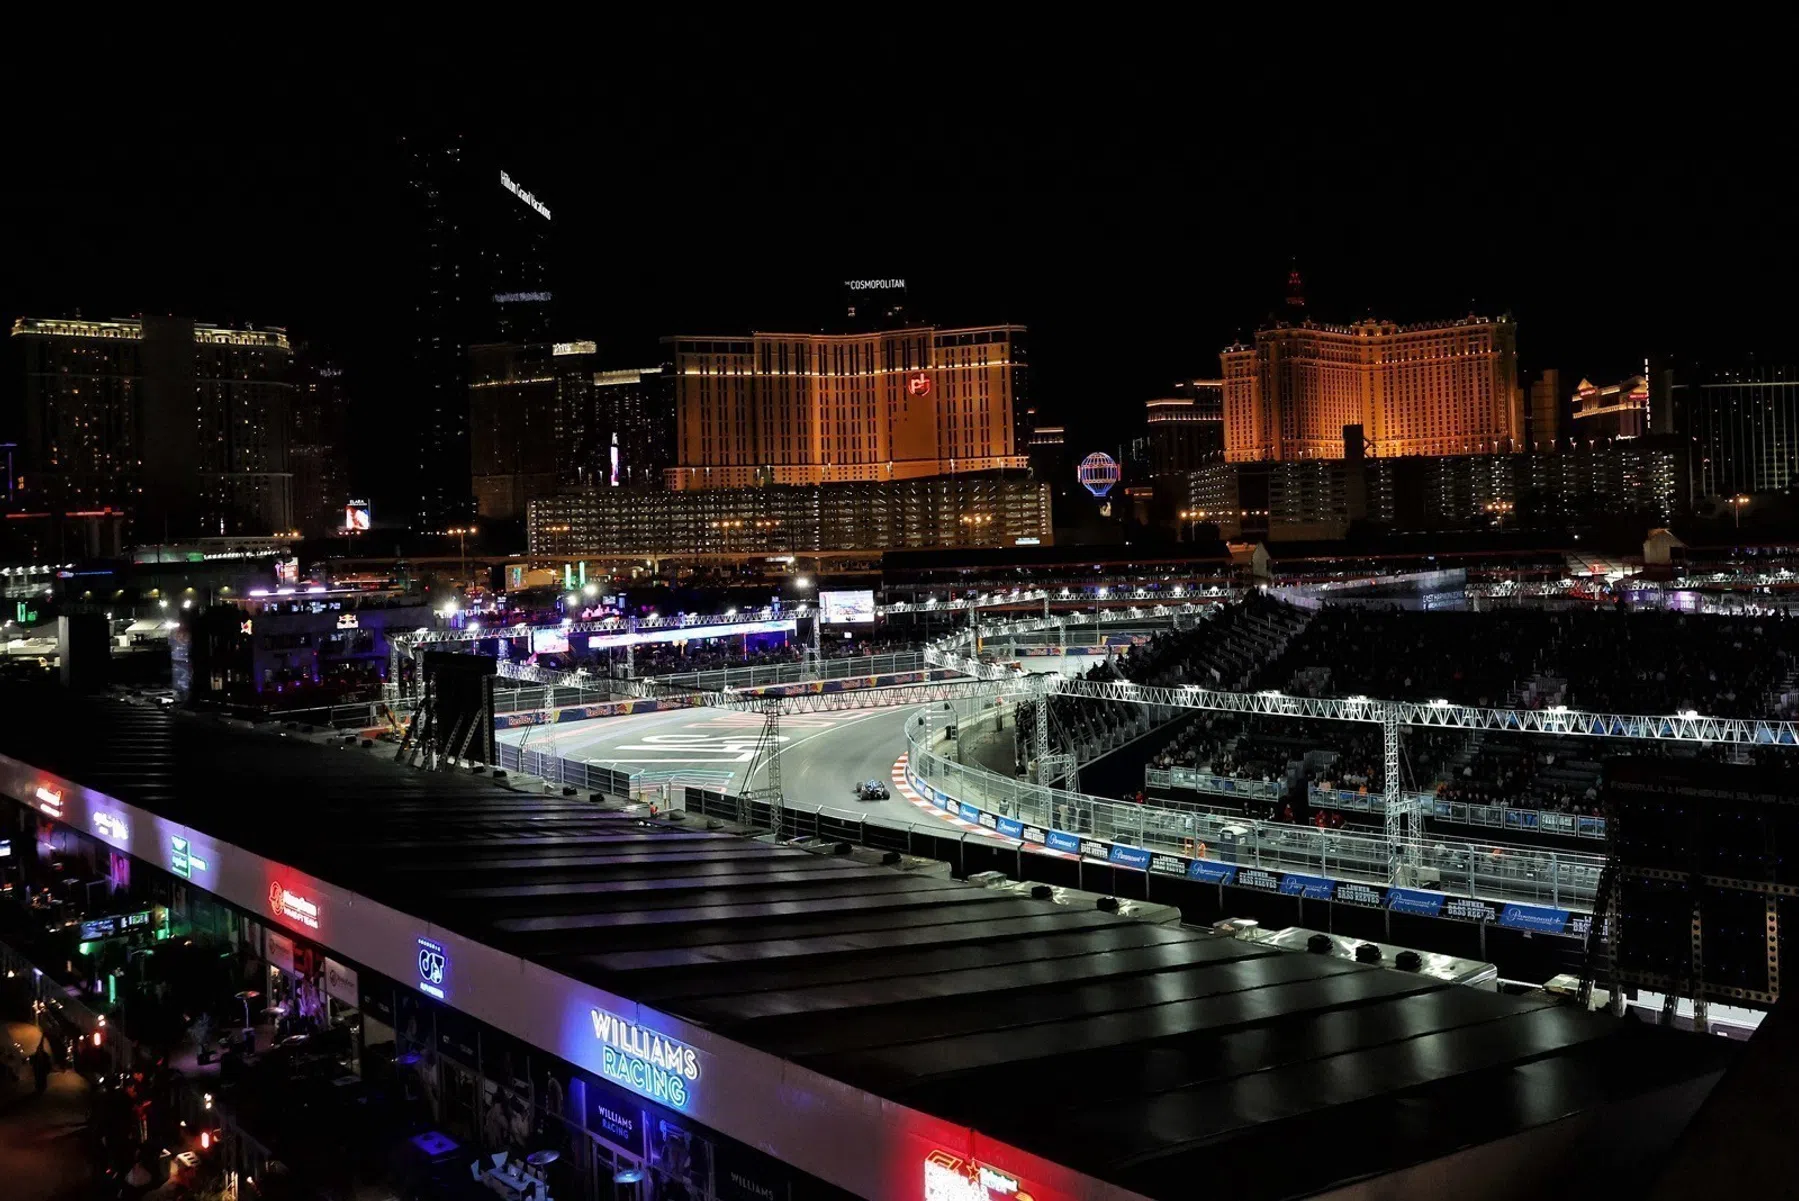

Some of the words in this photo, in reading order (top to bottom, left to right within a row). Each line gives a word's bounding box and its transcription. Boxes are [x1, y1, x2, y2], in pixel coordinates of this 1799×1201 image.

[500, 170, 516, 194] Hilton
[516, 183, 530, 206] Grand
[530, 192, 551, 220] Vacations
[850, 279, 905, 290] COSMOPOLITAN
[1338, 889, 1354, 900] BASS
[1354, 892, 1380, 904] REEVES
[1448, 904, 1466, 916] BASS
[1507, 908, 1560, 923] Paramount+
[591, 1009, 698, 1080] WILLIAMS
[603, 1046, 686, 1106] RACING
[598, 1105, 632, 1130] WILLIAMS
[602, 1118, 628, 1140] RACING
[730, 1171, 774, 1201] WILLIAMS
